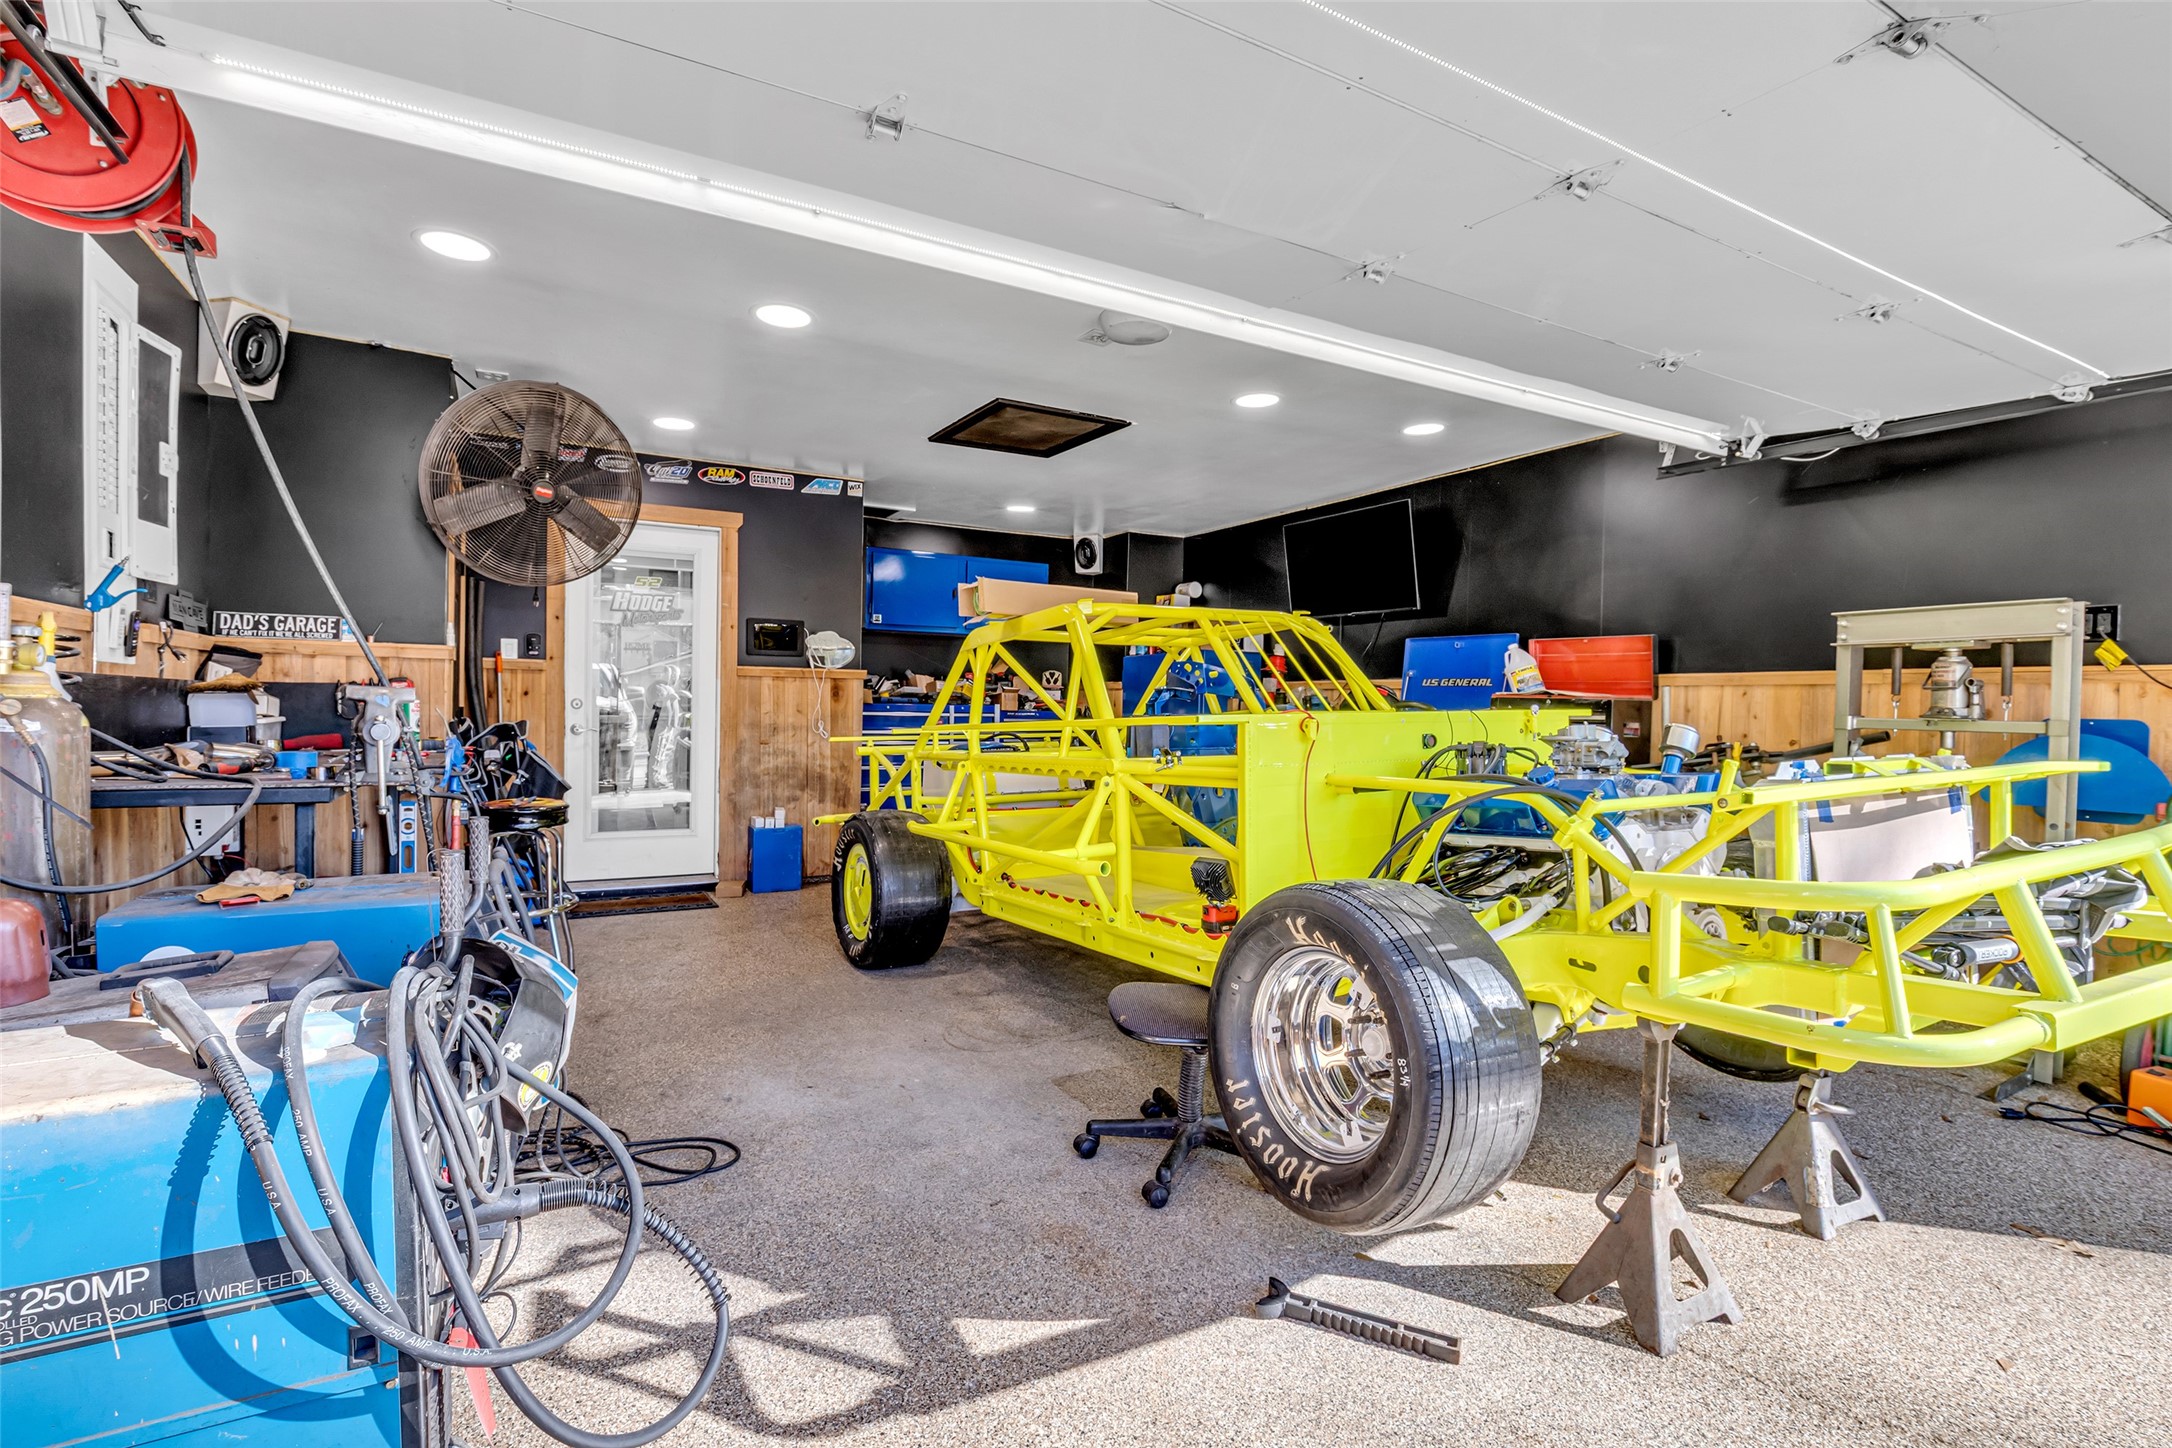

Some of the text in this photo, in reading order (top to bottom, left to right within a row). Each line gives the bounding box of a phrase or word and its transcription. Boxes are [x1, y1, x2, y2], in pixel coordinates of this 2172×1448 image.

[707, 468, 736, 478] RAM
[753, 474, 791, 486] SCHOENFELD
[848, 483, 862, 491] WIX
[634, 576, 663, 588] 52
[610, 591, 675, 613] HODGE
[219, 613, 337, 633] DAD'S GARAGE
[240, 629, 257, 637] CAN'T
[1440, 678, 1493, 687] GENERAL
[1396, 1058, 1408, 1075] 83
[282, 1046, 295, 1080] PROFAX
[291, 1109, 304, 1129] 250
[298, 1132, 313, 1157] AMP
[363, 1281, 394, 1316] PROFAX
[20, 1266, 150, 1316] 250MP
[321, 1276, 363, 1314] PROFAX
[382, 1326, 406, 1342] 250
[406, 1335, 433, 1350] AMP
[20, 1311, 102, 1343] POWER
